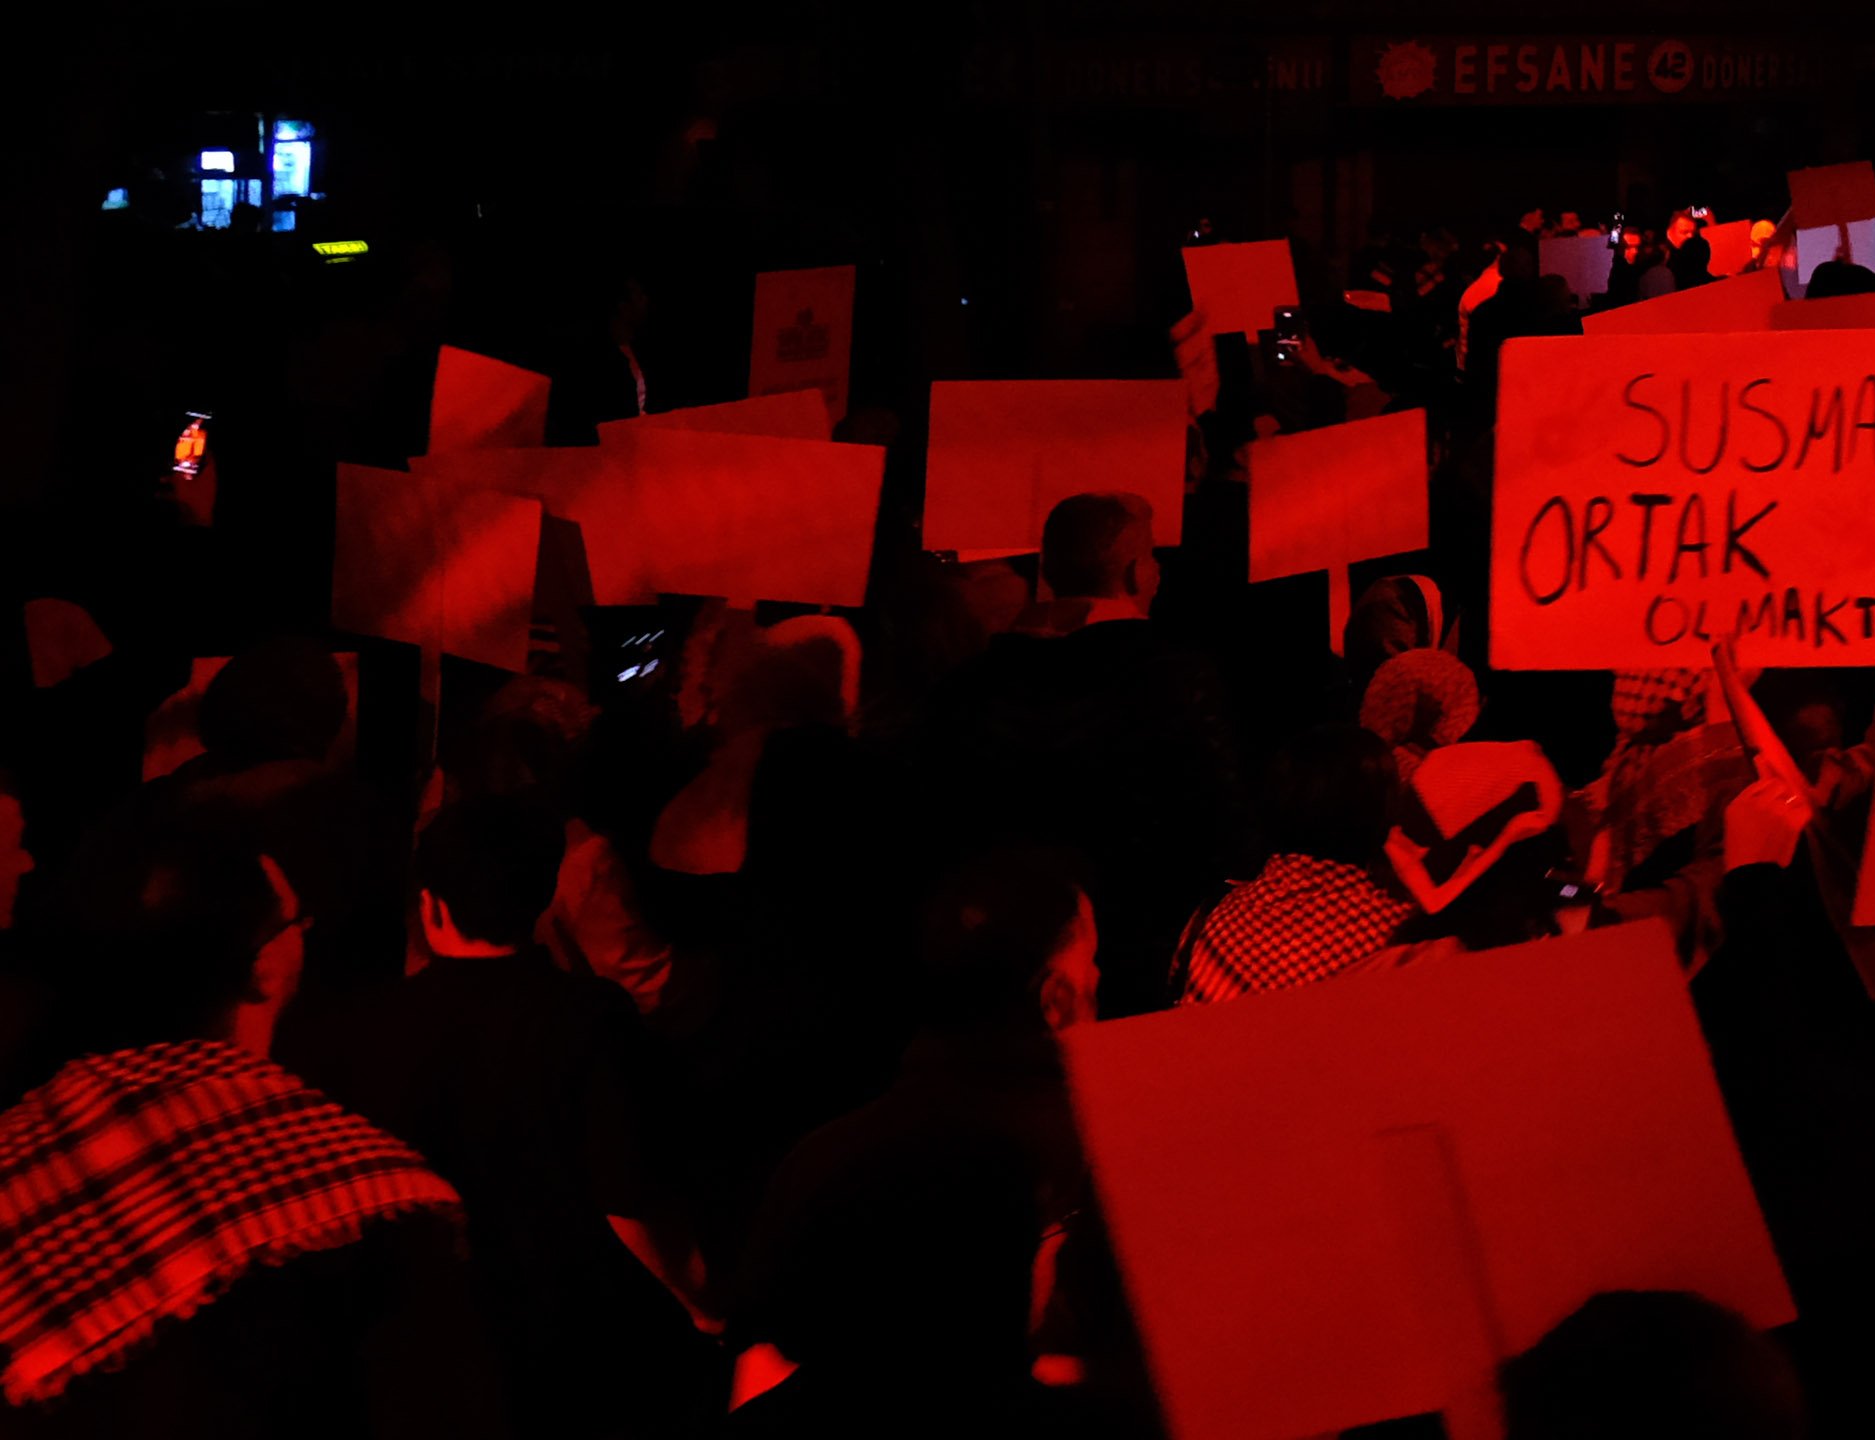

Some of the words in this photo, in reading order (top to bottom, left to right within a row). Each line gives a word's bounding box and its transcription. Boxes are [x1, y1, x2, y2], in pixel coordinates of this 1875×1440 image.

[1452, 41, 1636, 95] EFSANE
[1654, 51, 1688, 80] 42
[1519, 487, 1780, 607] ORTAK
